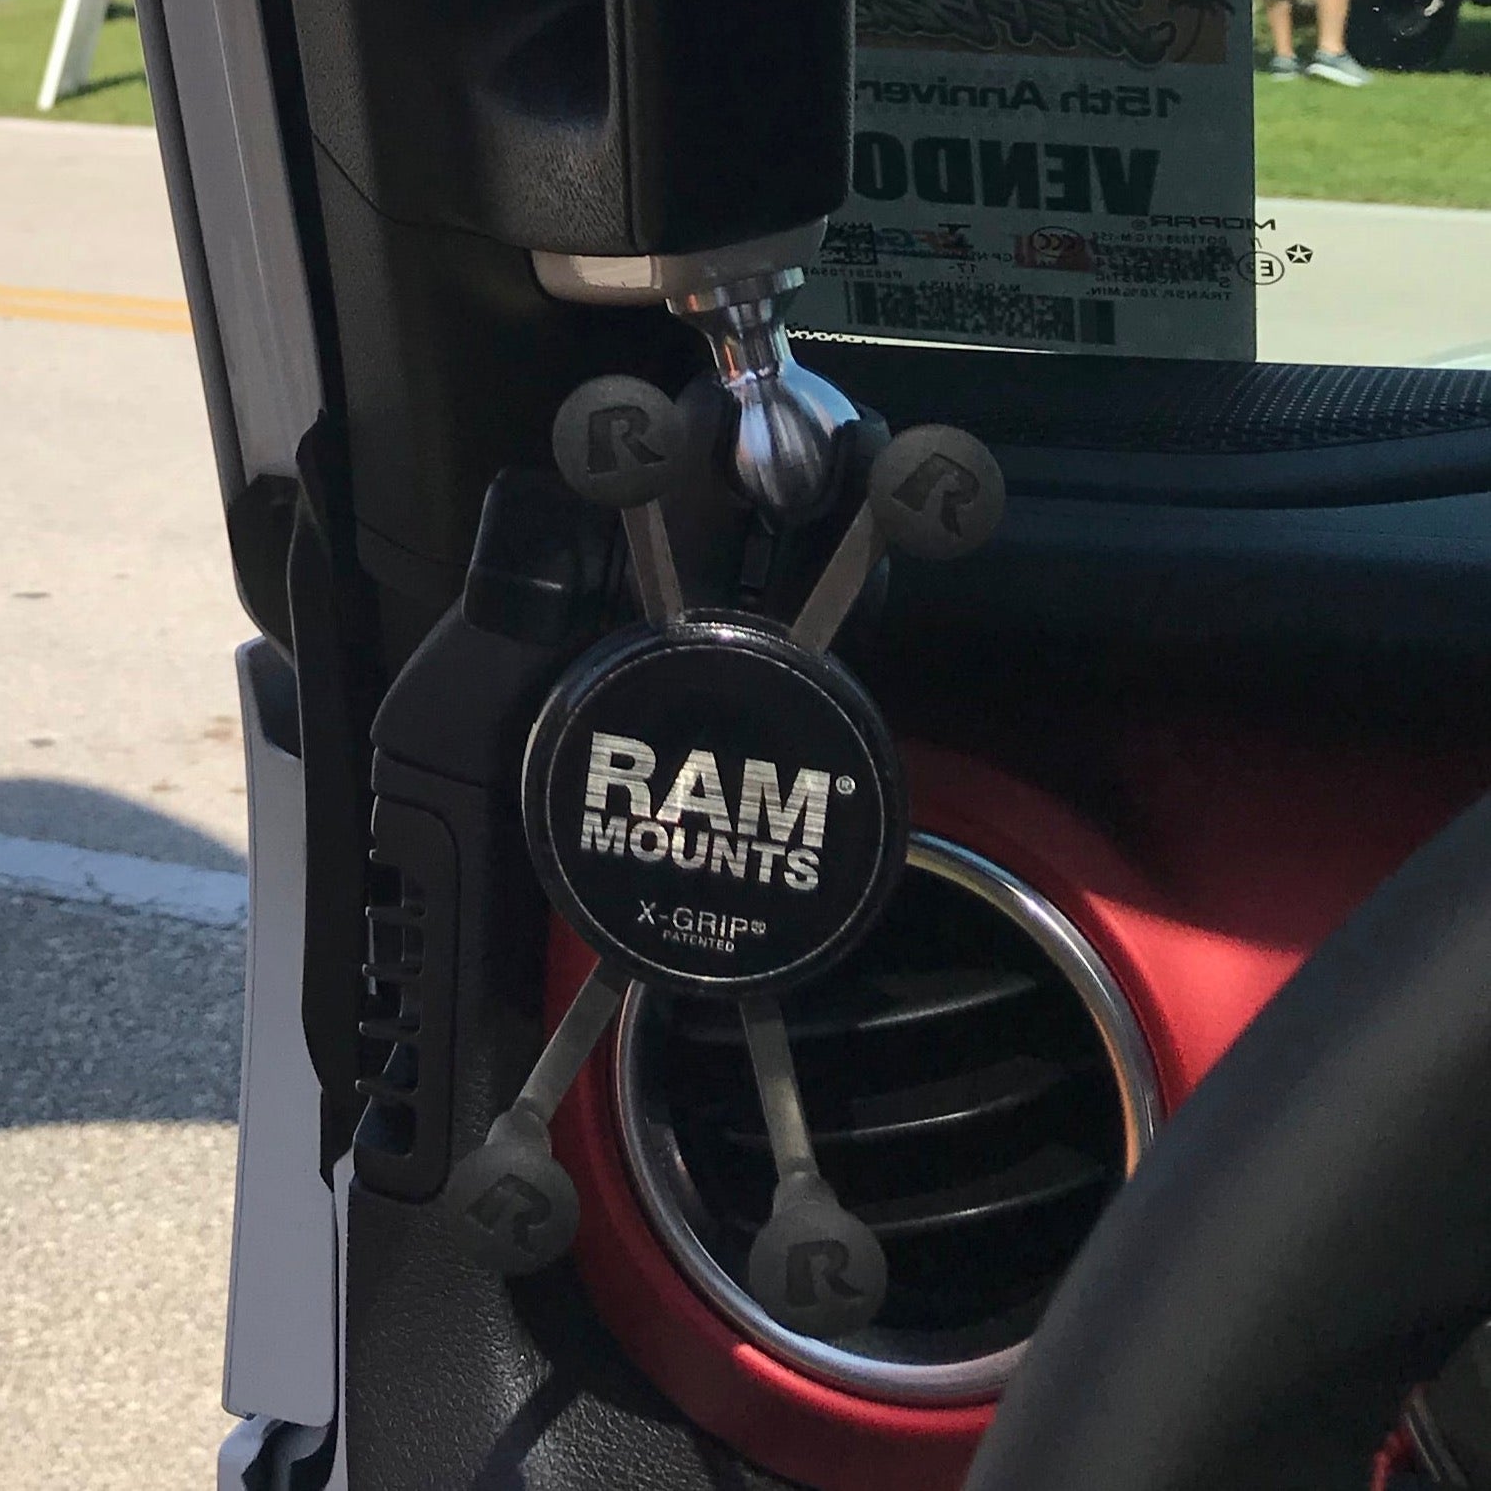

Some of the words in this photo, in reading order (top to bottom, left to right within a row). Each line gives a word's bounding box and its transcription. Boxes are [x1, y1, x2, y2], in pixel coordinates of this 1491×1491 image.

[587, 405, 666, 475] R
[580, 810, 821, 892] MOUNTS
[662, 929, 735, 953] PATENTED
